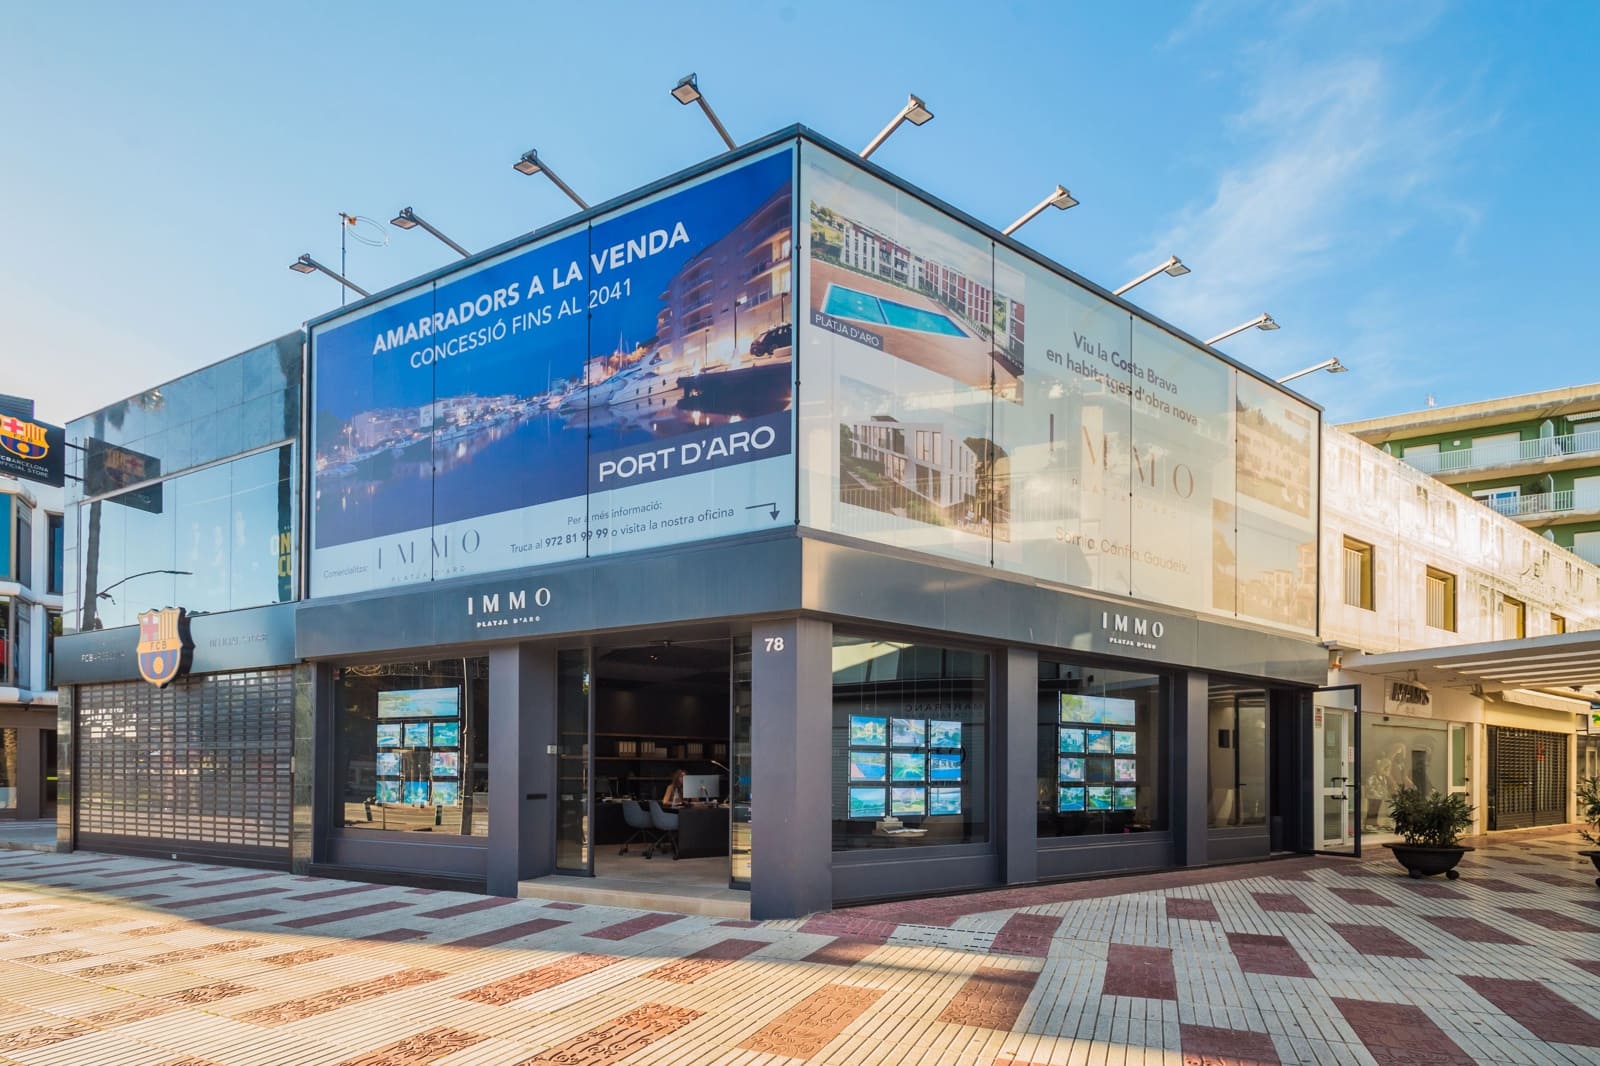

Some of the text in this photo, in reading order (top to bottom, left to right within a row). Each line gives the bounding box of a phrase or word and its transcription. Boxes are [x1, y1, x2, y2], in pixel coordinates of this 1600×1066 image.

[372, 221, 690, 355] AMARRADORS A LA VENDA
[410, 278, 631, 369] CONCESSIÓ FINS AL 2041
[815, 314, 880, 346] PLATJA D'ARO
[1073, 331, 1178, 395] Viu la Costa Brava
[1046, 349, 1198, 426] en habitatges d'obra nova
[0, 455, 49, 473] CBARCELONA
[600, 425, 775, 482] PORT D'ARO
[1050, 413, 1194, 499] IMMO
[0, 461, 49, 478] FFICIAL STORE
[567, 516, 582, 526] Per
[591, 510, 609, 521] més
[611, 500, 663, 519] informació:
[510, 543, 533, 553] Truca
[535, 538, 543, 549] al
[545, 535, 563, 547] 972
[565, 533, 577, 544] 81
[580, 530, 593, 541] 99
[596, 527, 609, 539] 99
[620, 522, 646, 535] visita
[649, 519, 658, 530] la
[661, 515, 695, 528] nostra
[697, 508, 735, 521] oficina
[378, 528, 480, 569] IMMO
[1100, 538, 1140, 561] Confa.
[467, 587, 551, 615] IMMO
[476, 616, 541, 628] PLATJA D'ARO
[1102, 611, 1164, 638] IMMO
[150, 640, 167, 651] FCB
[764, 637, 785, 652] 78
[1109, 637, 1157, 650] PLATJA D'ARO
